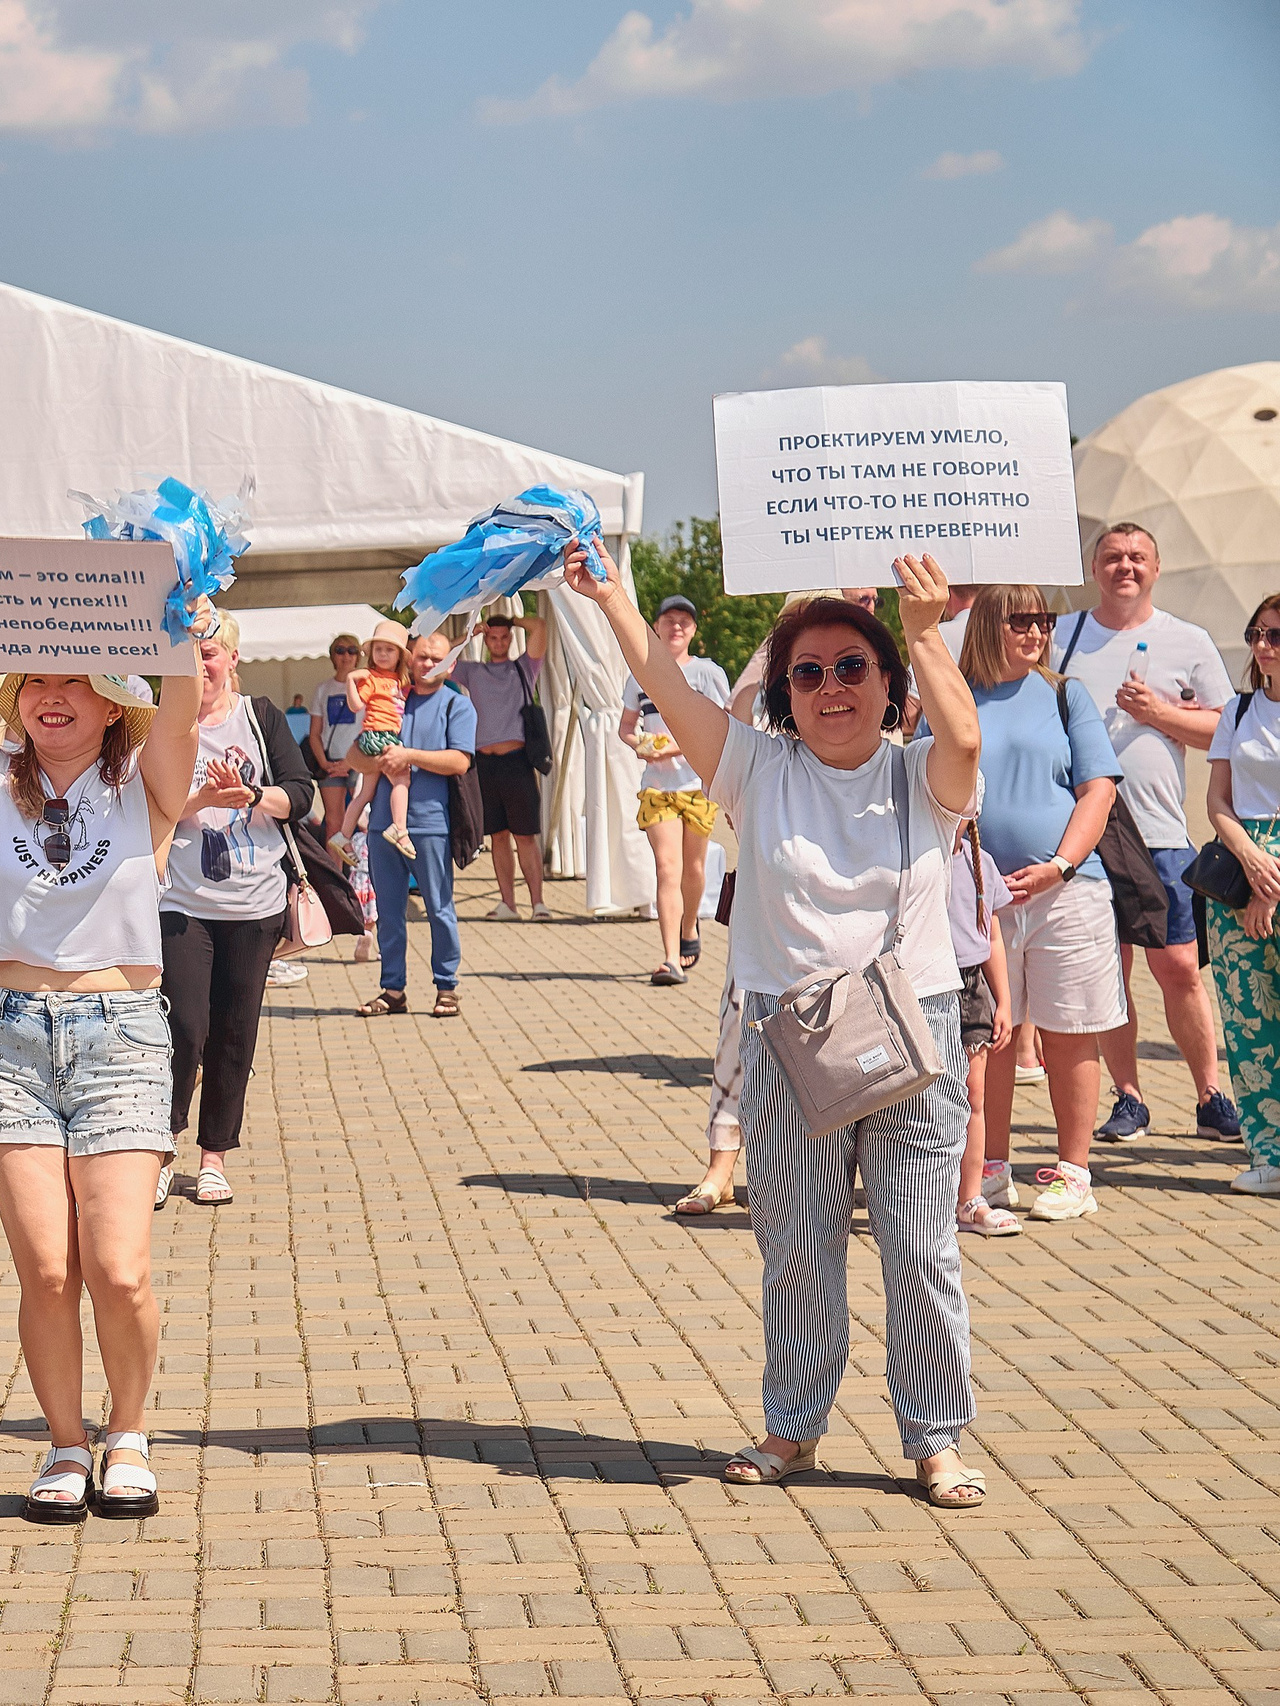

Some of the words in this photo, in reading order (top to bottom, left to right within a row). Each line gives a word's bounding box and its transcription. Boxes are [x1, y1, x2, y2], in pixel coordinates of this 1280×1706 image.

[779, 431, 925, 451] ПРОЕКТИРУЕМ
[930, 429, 1008, 446] УМЕЛО,
[772, 468, 811, 483] ЧТО
[816, 466, 845, 480] ТЫ
[851, 464, 895, 479] ТАМ
[902, 463, 927, 477] НЕ
[933, 460, 1019, 476] ГОВОРИ!
[767, 497, 818, 515] ЕСЛИ
[824, 495, 896, 510] ЧТО-ТО
[903, 493, 928, 508] НЕ
[934, 492, 1029, 507] ПОНЯТНО
[780, 529, 810, 545] ТЫ
[816, 525, 894, 541] ЧЕРТЕЖ
[900, 522, 1019, 539] ПЕРЕВЕРНИ!
[37, 572, 68, 582] это
[75, 570, 145, 584] сила!!!
[30, 596, 42, 606] и
[48, 595, 127, 609] успех!!!
[38, 645, 101, 657] лучше
[108, 643, 158, 656] всех!
[12, 836, 39, 870] JUST
[37, 839, 111, 886] HAPPINESS
